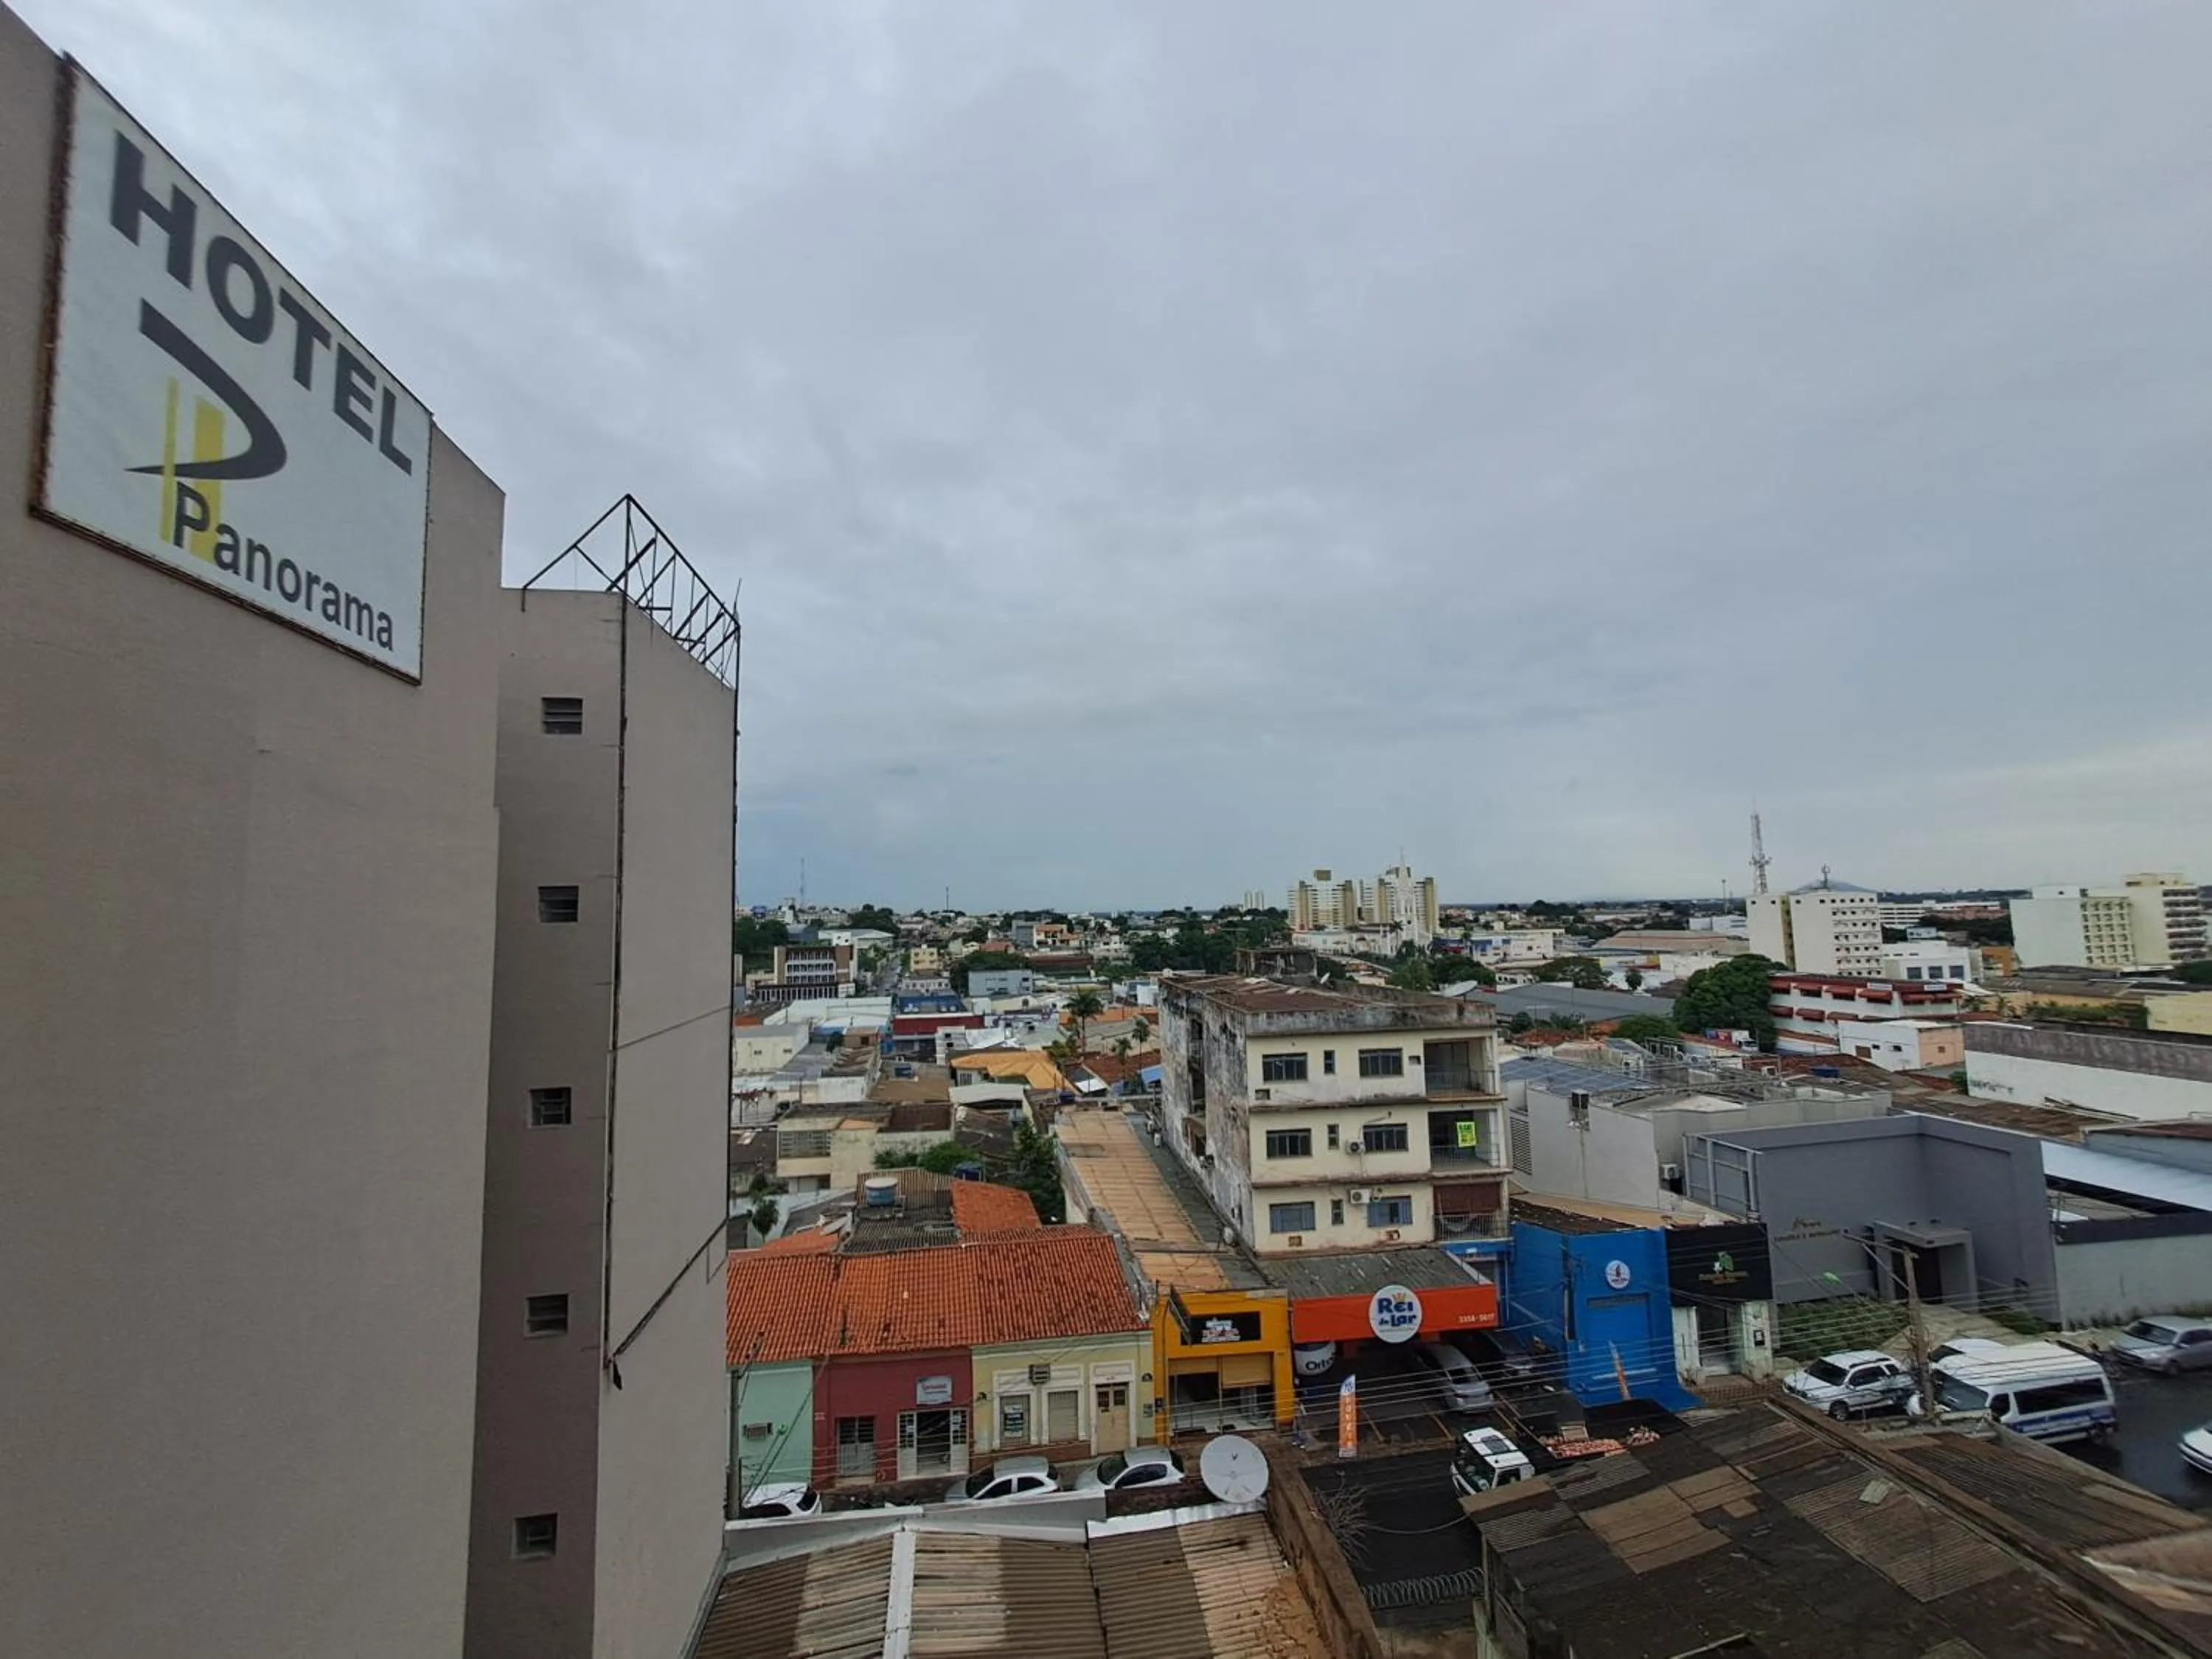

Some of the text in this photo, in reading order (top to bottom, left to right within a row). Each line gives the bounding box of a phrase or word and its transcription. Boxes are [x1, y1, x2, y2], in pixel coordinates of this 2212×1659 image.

[110, 129, 413, 476] HOTEL
[173, 481, 394, 653] Panorama
[1390, 1314, 1417, 1327] Lar
